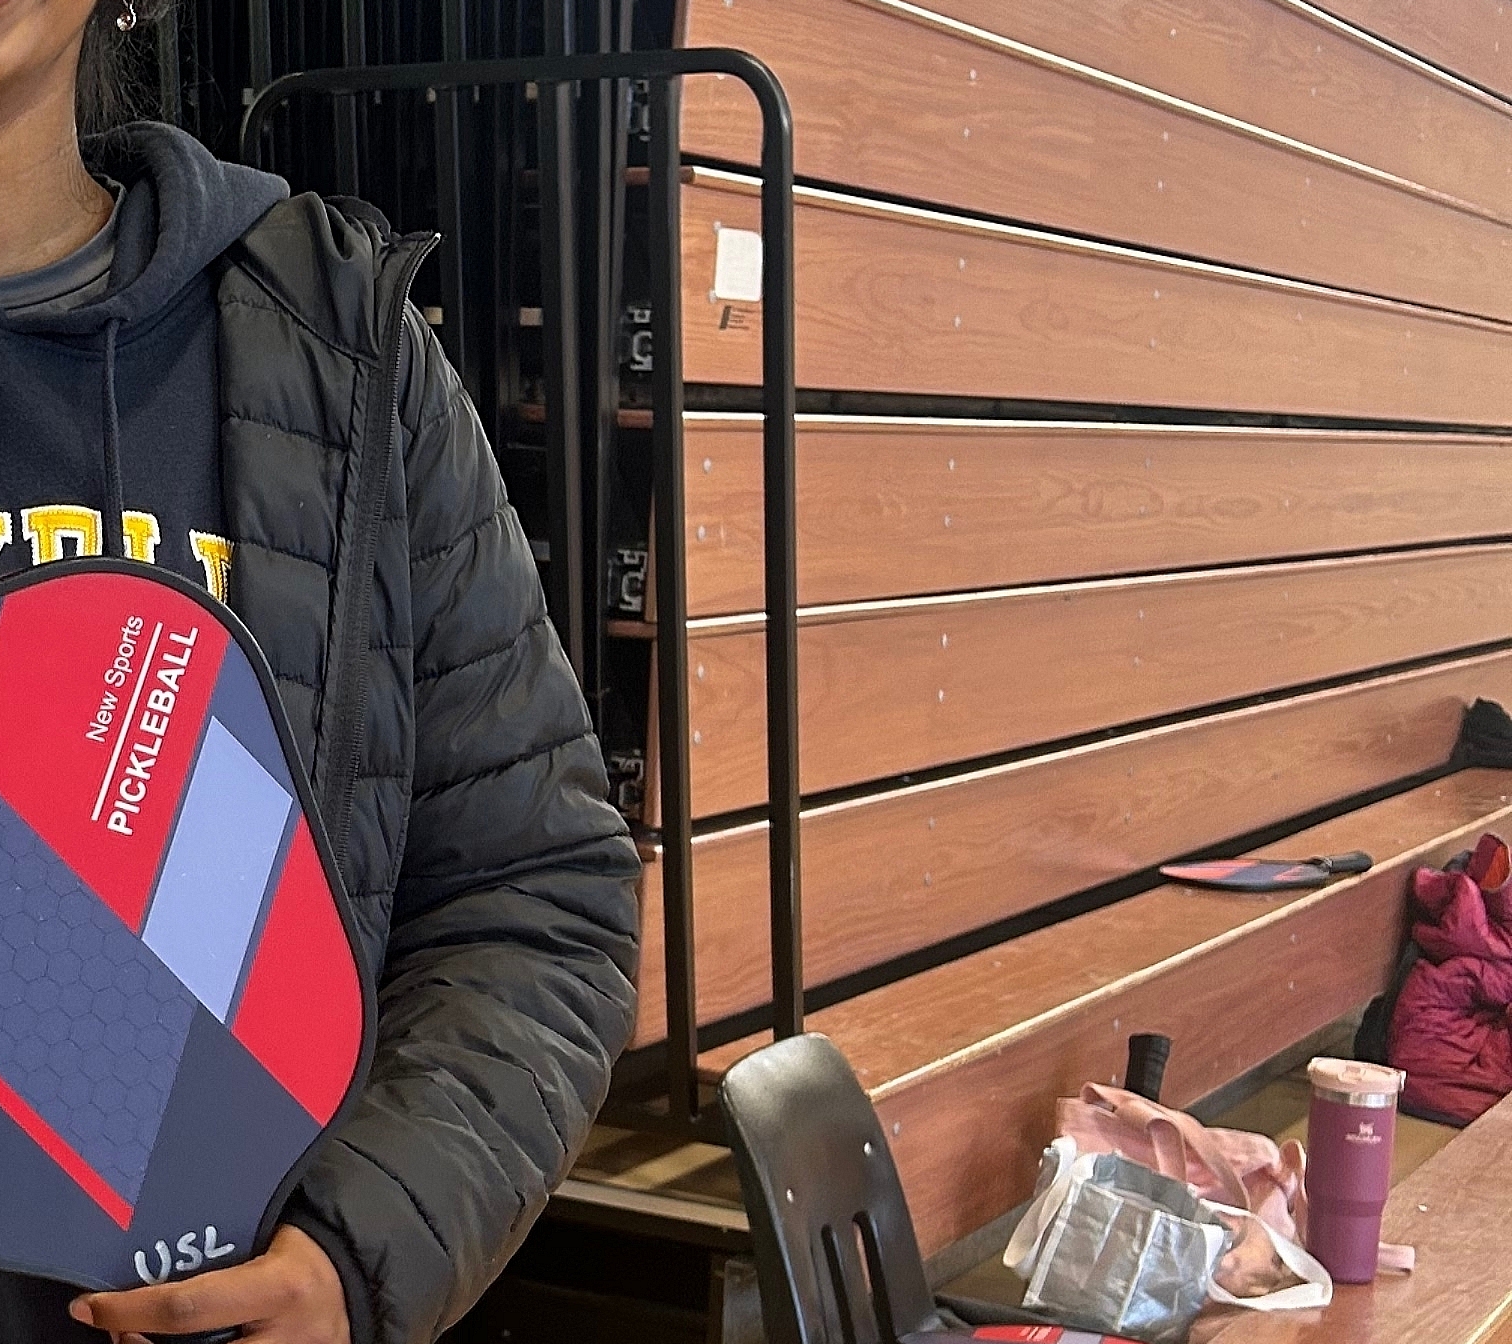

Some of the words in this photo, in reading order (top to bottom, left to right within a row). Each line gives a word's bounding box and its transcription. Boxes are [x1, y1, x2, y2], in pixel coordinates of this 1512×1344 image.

[86, 691, 118, 742] New
[104, 615, 144, 688] Sports
[107, 627, 199, 836] PICKLEBALL
[135, 1225, 235, 1285] USL
